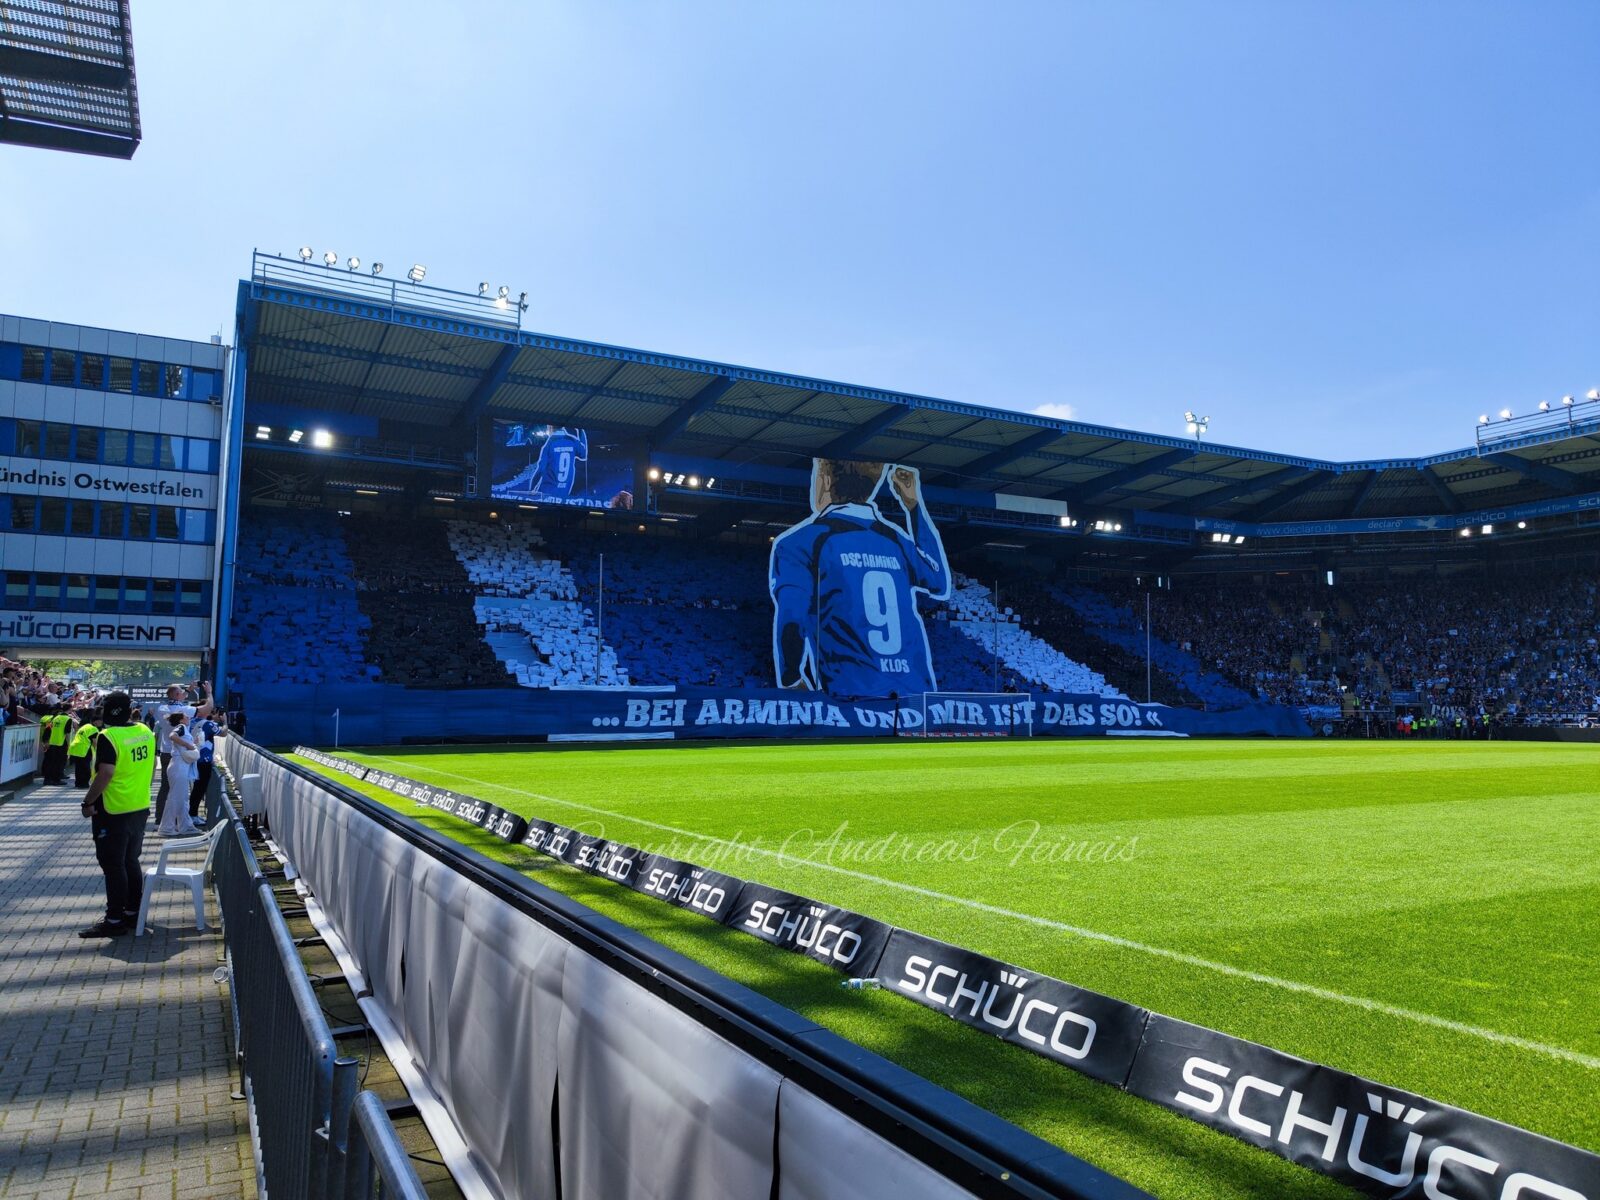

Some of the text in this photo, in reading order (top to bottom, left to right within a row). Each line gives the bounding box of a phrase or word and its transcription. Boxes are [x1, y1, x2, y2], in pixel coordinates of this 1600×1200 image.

[557, 452, 570, 482] 9
[74, 473, 204, 498] Ostwestfalen
[1456, 511, 1506, 526] SCHÜCO
[840, 552, 862, 567] DSC
[862, 570, 901, 655] 9
[879, 658, 910, 673] KLOS
[695, 699, 850, 727] ARMINIA
[854, 706, 923, 729] UND
[928, 699, 987, 725] MIR
[990, 701, 1036, 726] IST
[1043, 702, 1095, 726] DAS
[131, 745, 148, 763] 193
[456, 800, 485, 823] SCHÜCO
[485, 809, 514, 838] SCHÜCO
[525, 827, 570, 857] SCHÜCO
[574, 844, 632, 880] SCHÜCO
[644, 870, 725, 914] SCHÜCO
[744, 905, 862, 964] SCHÜCO
[898, 954, 1097, 1060] SCHÜCO
